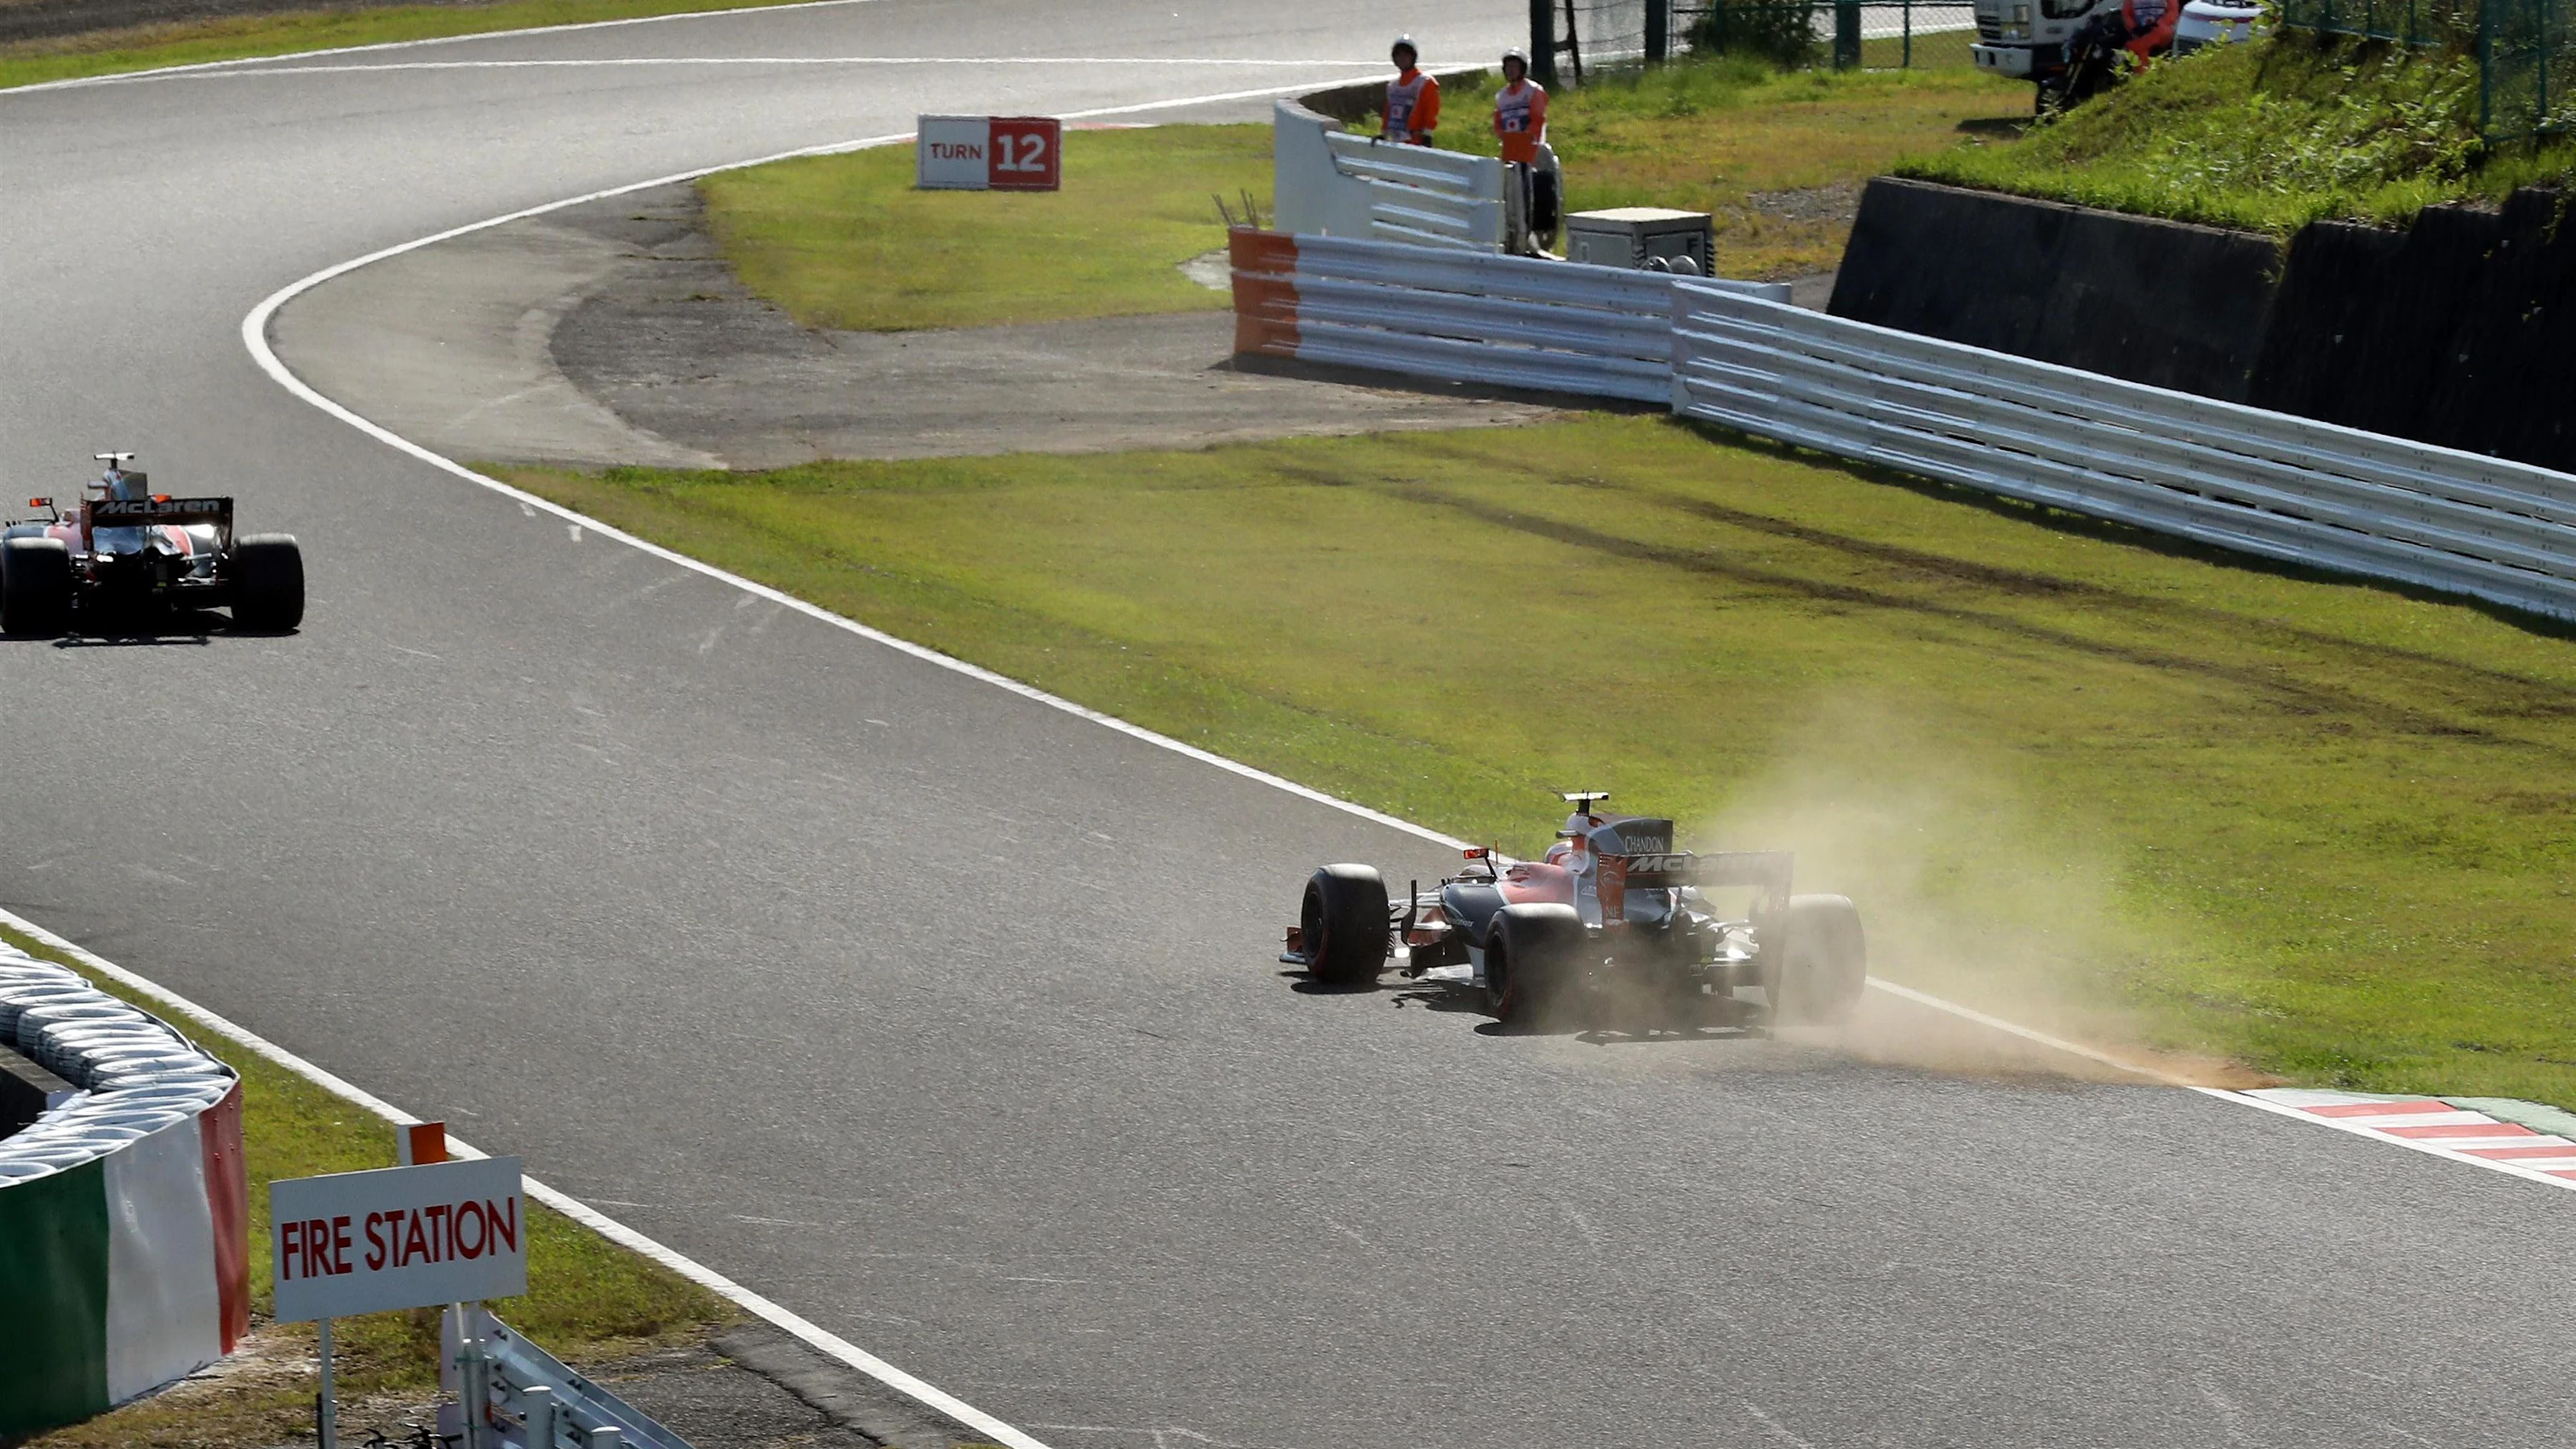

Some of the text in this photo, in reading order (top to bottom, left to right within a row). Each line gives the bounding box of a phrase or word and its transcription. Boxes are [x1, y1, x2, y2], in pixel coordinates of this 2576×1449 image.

[931, 134, 1046, 171] TURN 12
[96, 500, 220, 514] McLaren
[1624, 836, 1665, 852] CHANDON
[1626, 856, 1770, 873] McLa
[282, 1196, 516, 1280] FIRE STATION
